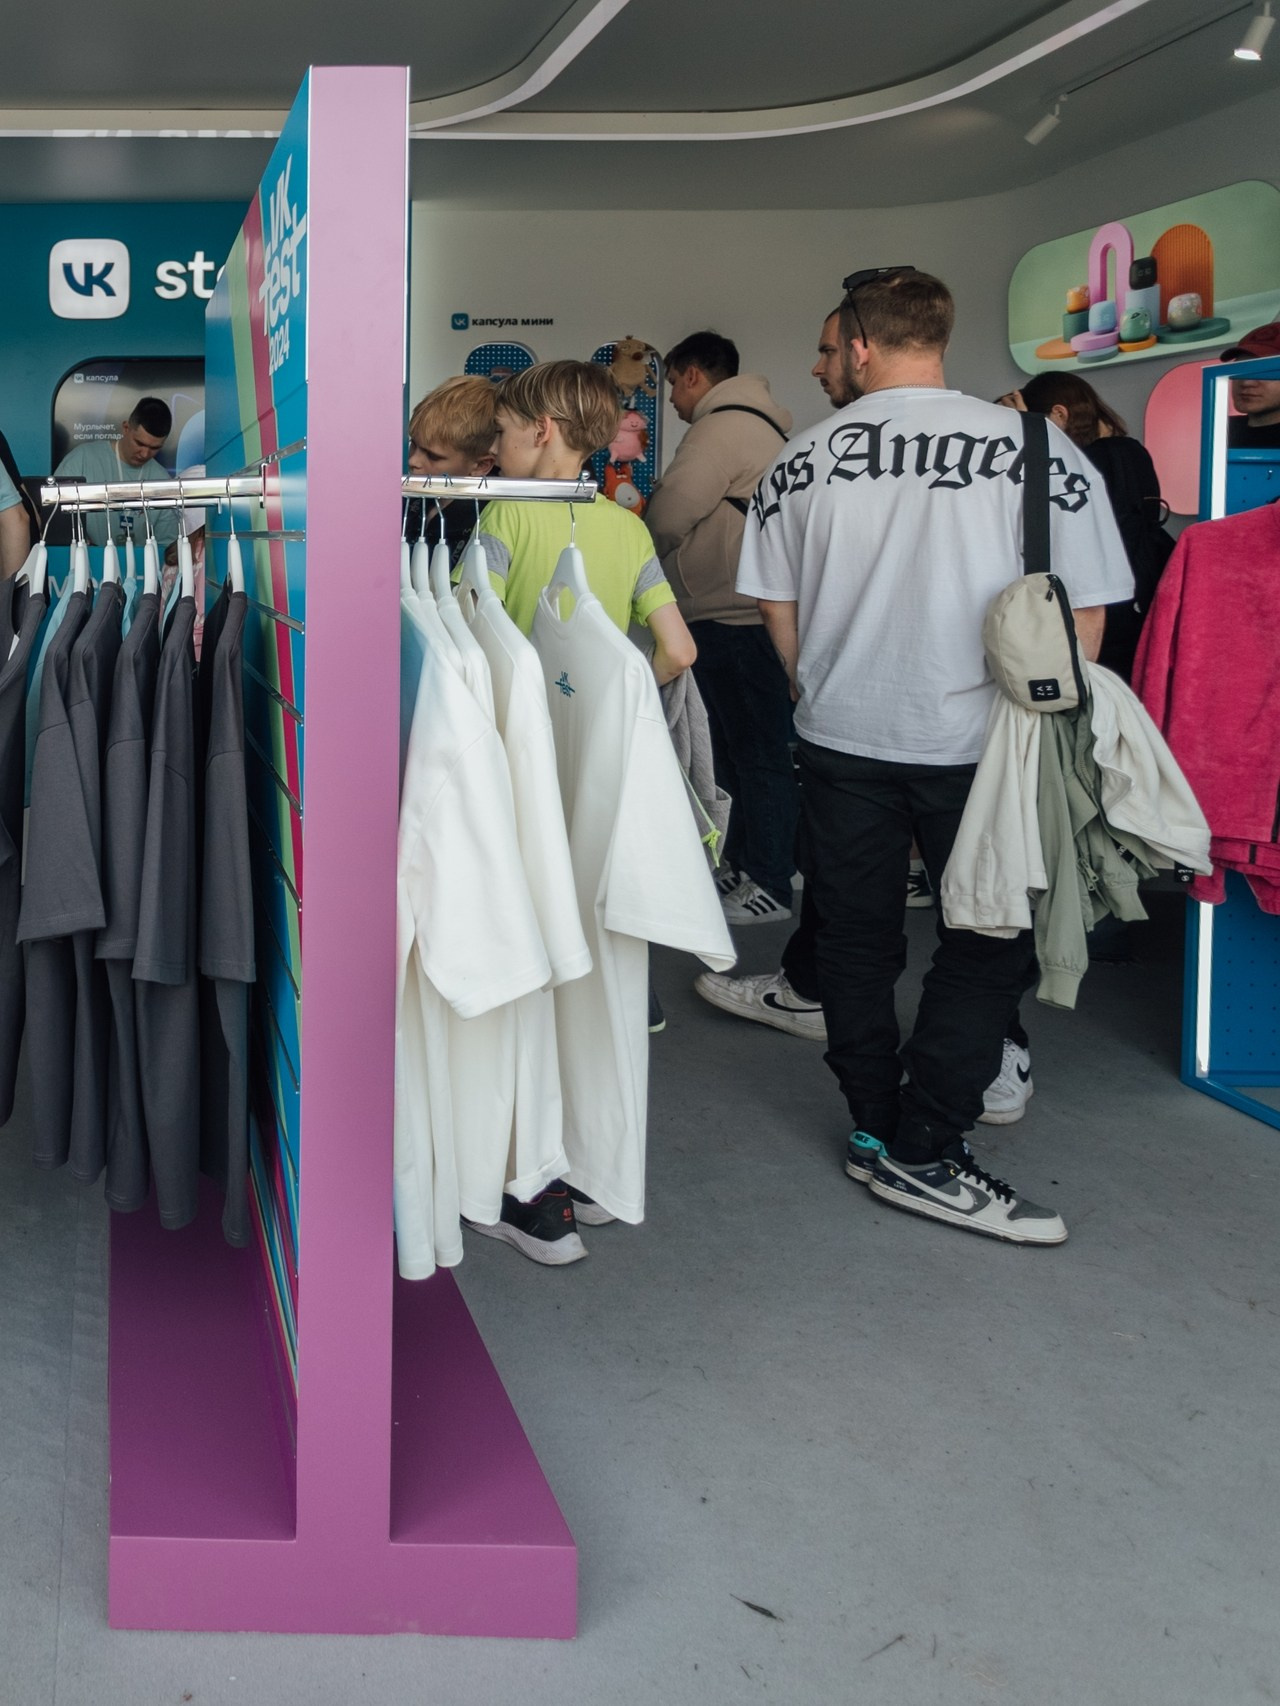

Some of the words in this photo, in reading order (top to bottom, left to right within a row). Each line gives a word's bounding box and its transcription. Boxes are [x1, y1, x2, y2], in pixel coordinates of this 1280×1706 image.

[269, 153, 293, 254] VK
[62, 262, 117, 297] VK
[154, 251, 226, 300] st
[259, 203, 307, 337] fest
[269, 318, 290, 377] 2024
[471, 318, 518, 328] капсула
[521, 318, 554, 326] мини
[86, 375, 119, 383] капсула
[752, 440, 816, 532] Los
